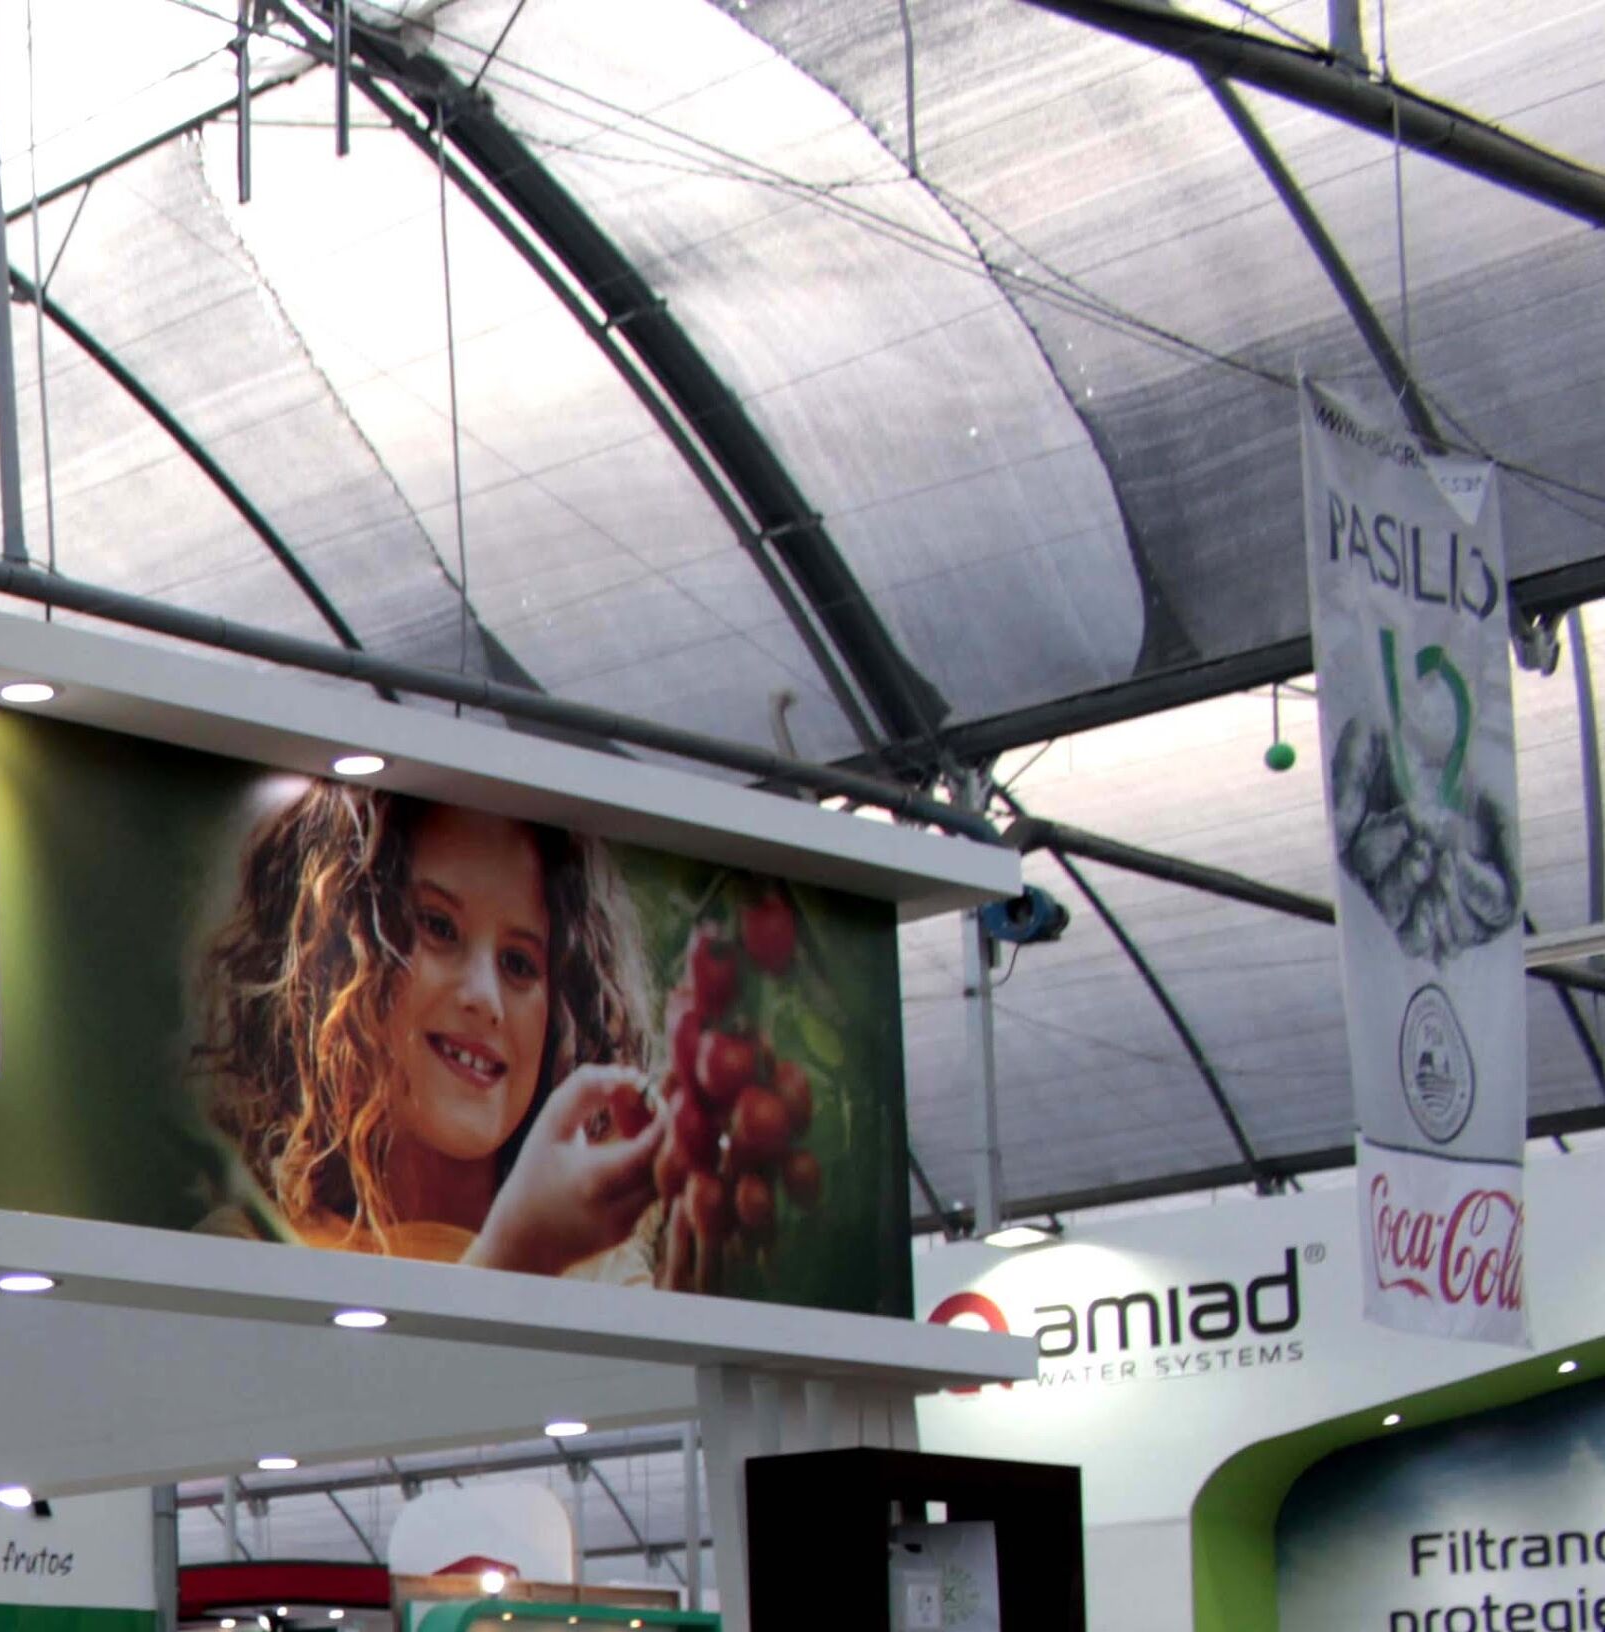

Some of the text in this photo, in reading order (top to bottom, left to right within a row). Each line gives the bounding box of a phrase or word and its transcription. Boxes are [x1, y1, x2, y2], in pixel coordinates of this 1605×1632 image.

[1034, 1247, 1301, 1358] amiad
[1036, 1341, 1305, 1388] WATER SYSTEMS
[2, 1541, 74, 1576] frutos
